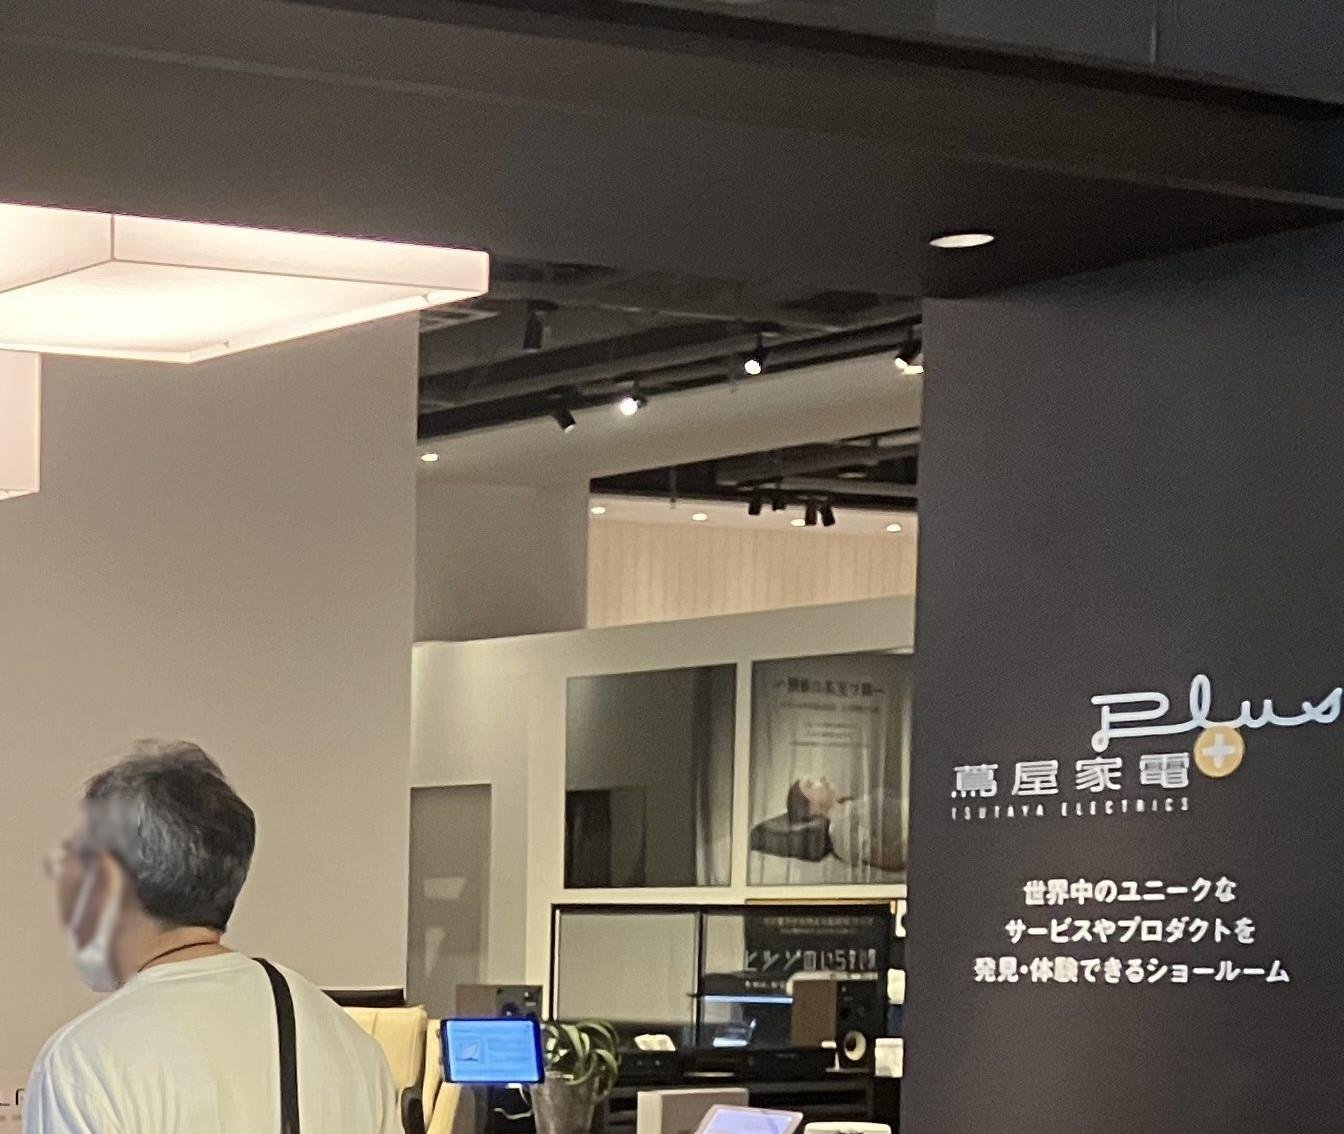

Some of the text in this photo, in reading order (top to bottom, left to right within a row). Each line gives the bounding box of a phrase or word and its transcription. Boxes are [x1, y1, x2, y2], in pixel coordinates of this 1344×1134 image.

[1091, 674, 1343, 752] Plus
[952, 796, 1190, 821] TSUTAYA ELECTRICS
[1023, 877, 1237, 905] 世界中のユニークな
[1005, 917, 1256, 944] サービスやプロダクトを
